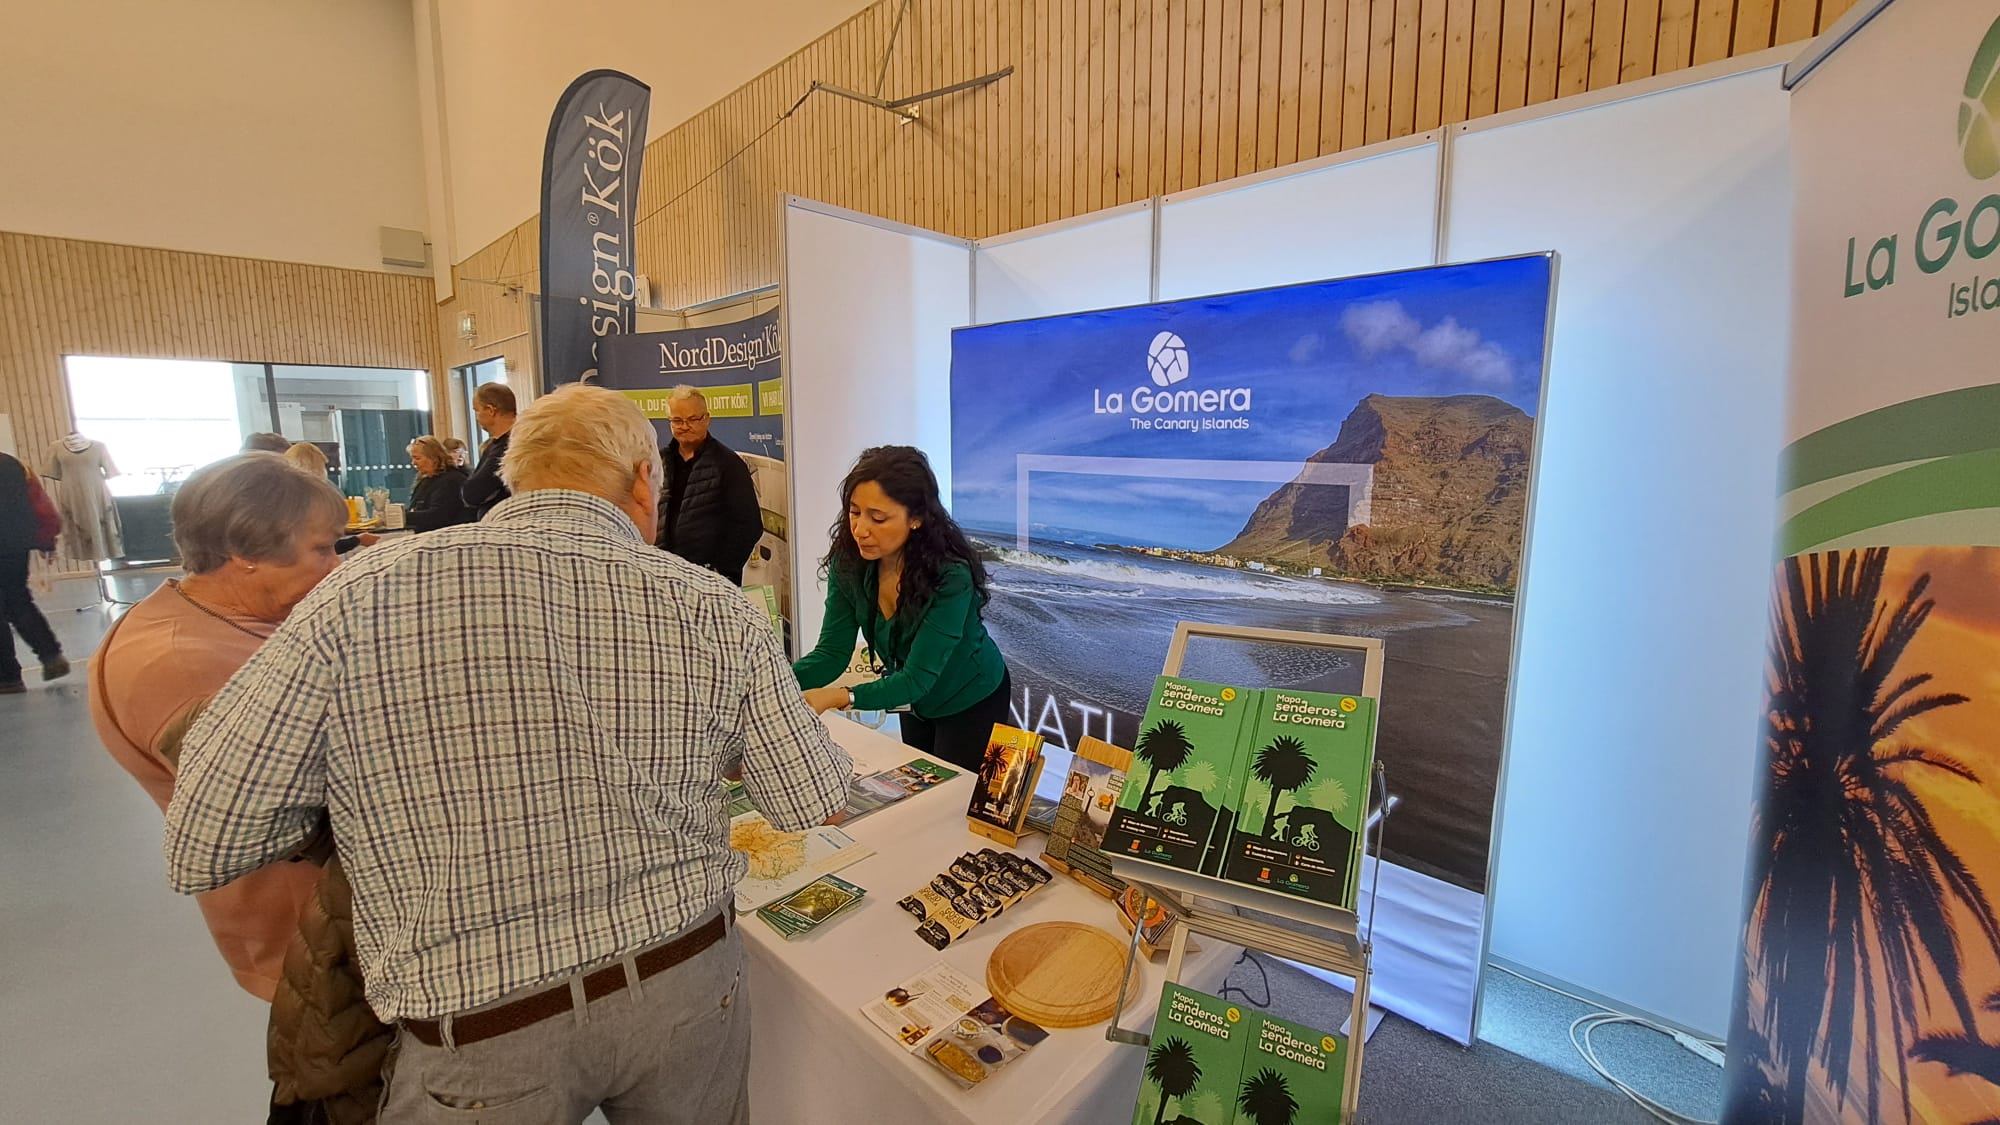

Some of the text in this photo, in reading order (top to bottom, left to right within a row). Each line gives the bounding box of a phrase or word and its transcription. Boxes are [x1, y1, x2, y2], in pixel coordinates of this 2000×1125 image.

[582, 102, 624, 218] Kök
[1844, 194, 2000, 298] La Go
[1948, 275, 2000, 319] Isla
[647, 398, 660, 411] DU
[1094, 386, 1251, 414] La Gomera
[1130, 416, 1250, 432] The Canary Islands
[1165, 681, 1187, 692] Mapa
[1160, 697, 1223, 716] La Gomera
[1163, 689, 1218, 705] senderos
[1276, 694, 1301, 704] Mapa
[1010, 687, 1113, 751] NATI
[1275, 702, 1338, 717] senderos
[1273, 711, 1346, 729] La Gomera
[1173, 991, 1194, 1005] Mapa
[1171, 1000, 1224, 1025] senderos
[1168, 1008, 1182, 1022] La
[1184, 1015, 1229, 1039] Gomera
[1262, 1019, 1285, 1034] Mapa
[1261, 1029, 1319, 1055] senderos
[1259, 1038, 1326, 1070] La Gomera
